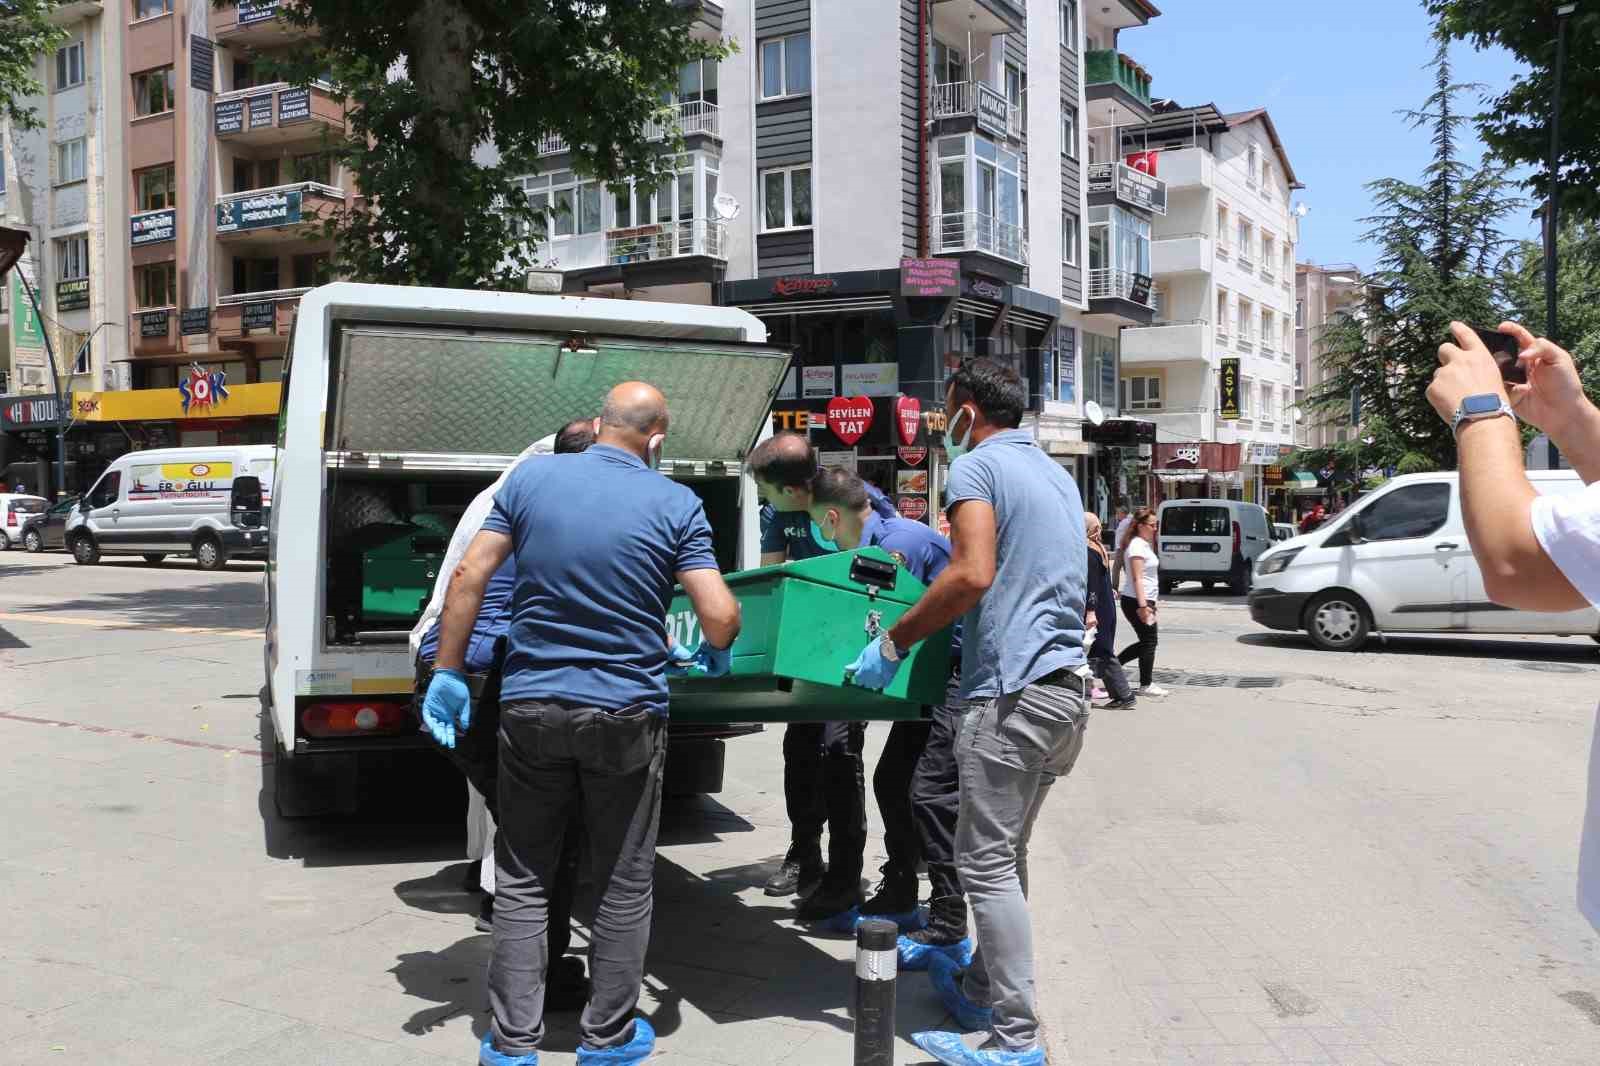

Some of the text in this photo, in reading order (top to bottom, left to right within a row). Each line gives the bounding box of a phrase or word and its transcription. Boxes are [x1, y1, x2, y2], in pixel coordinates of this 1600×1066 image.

[981, 92, 1005, 118] AVUKAT
[59, 280, 88, 293] AVUKAT
[1225, 366, 1235, 408] ASYA
[829, 407, 872, 419] SEVİLEN
[839, 421, 865, 434] TAT
[904, 422, 917, 433] TAT
